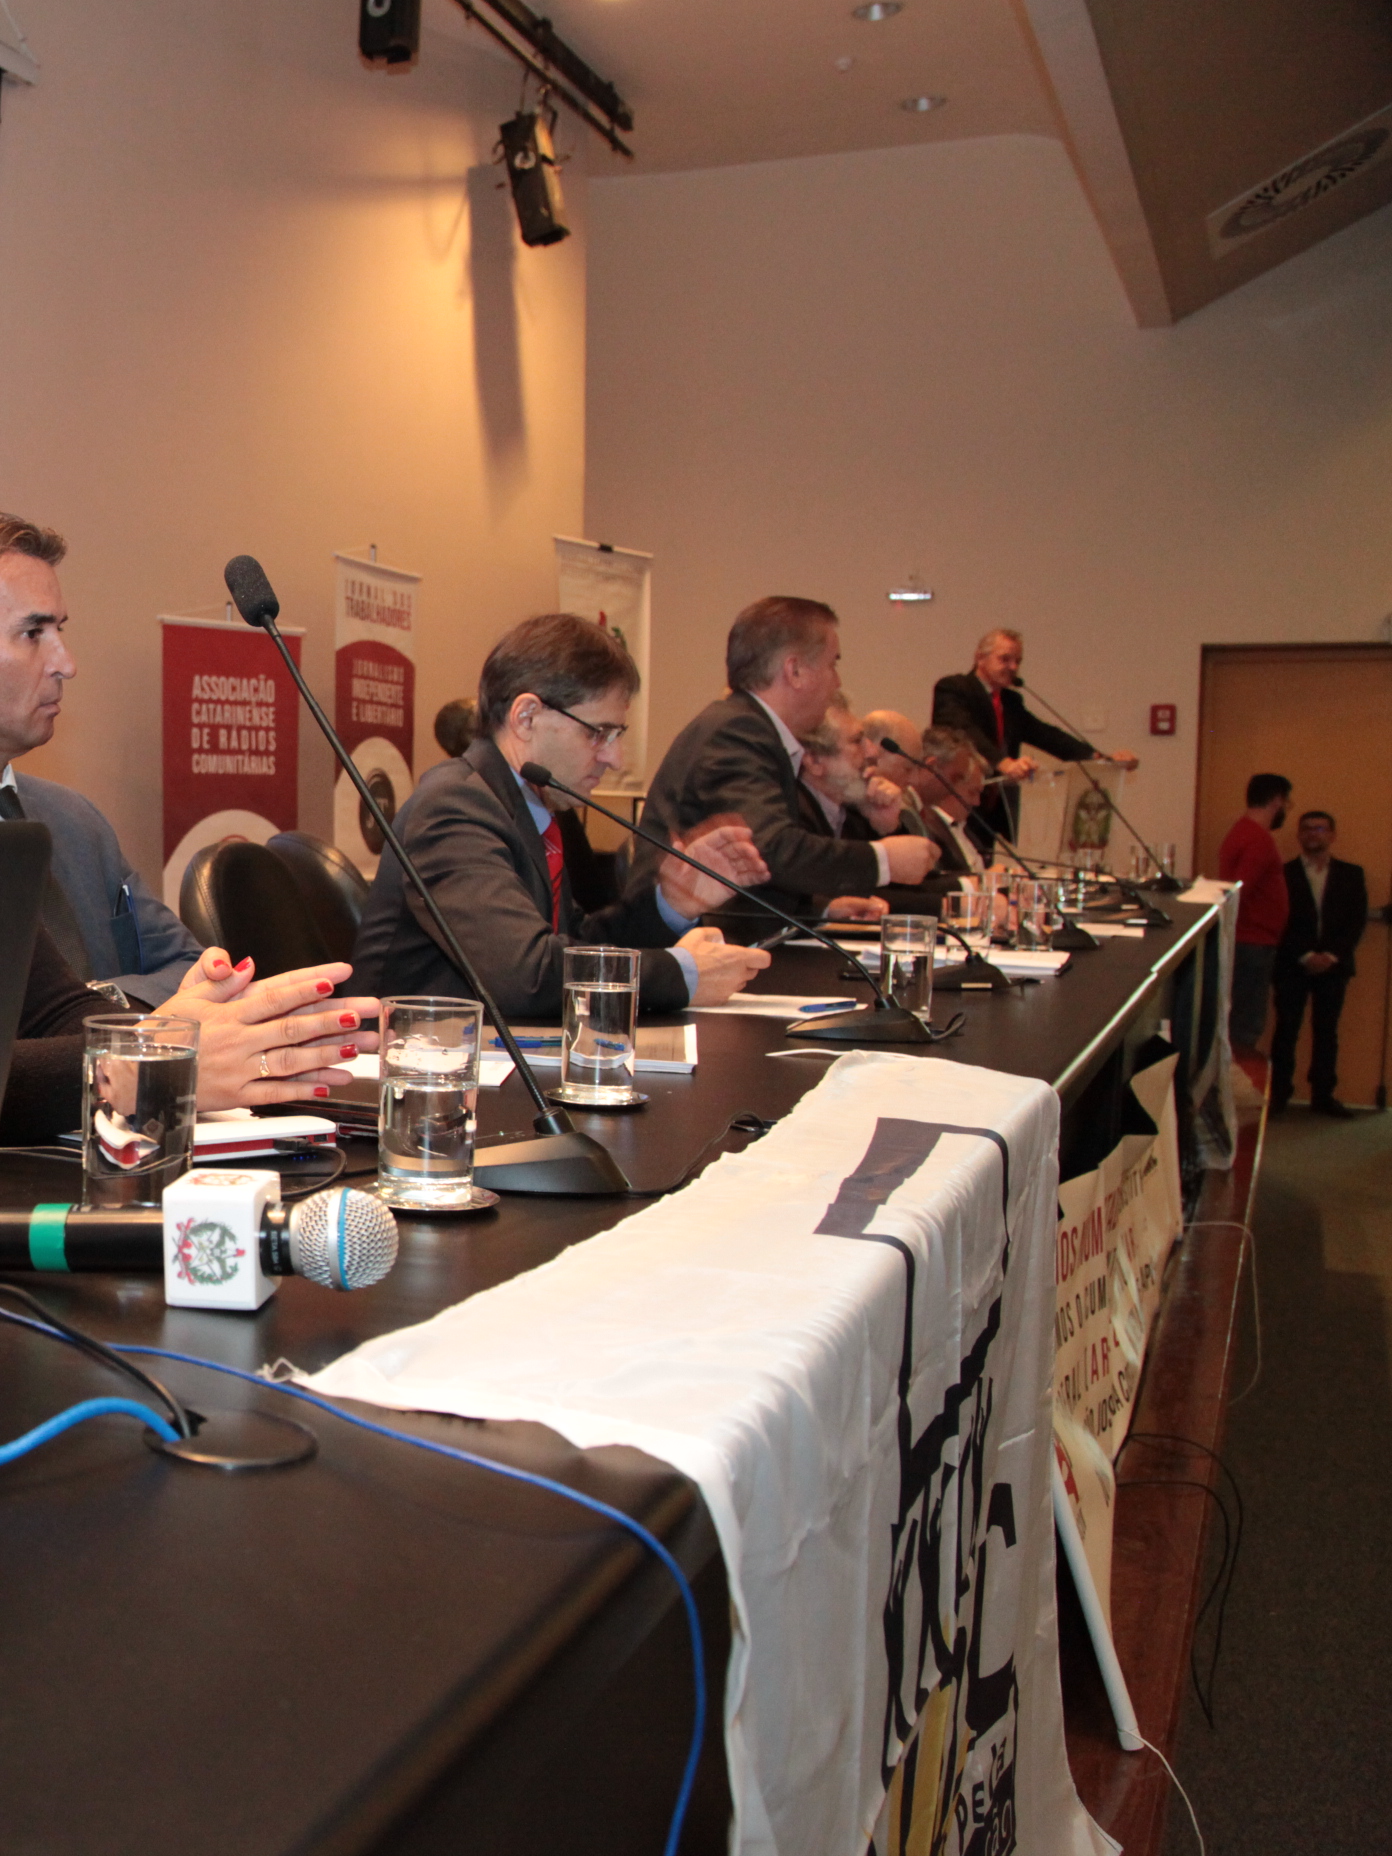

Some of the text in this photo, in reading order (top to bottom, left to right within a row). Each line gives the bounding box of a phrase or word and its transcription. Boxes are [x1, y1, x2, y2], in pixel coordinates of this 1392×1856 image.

[192, 674, 275, 706] ASSOCIAÇÃO
[191, 702, 276, 728] CATARINENSE
[191, 727, 211, 749] DE
[192, 751, 276, 776] COMUNITÁRIAS
